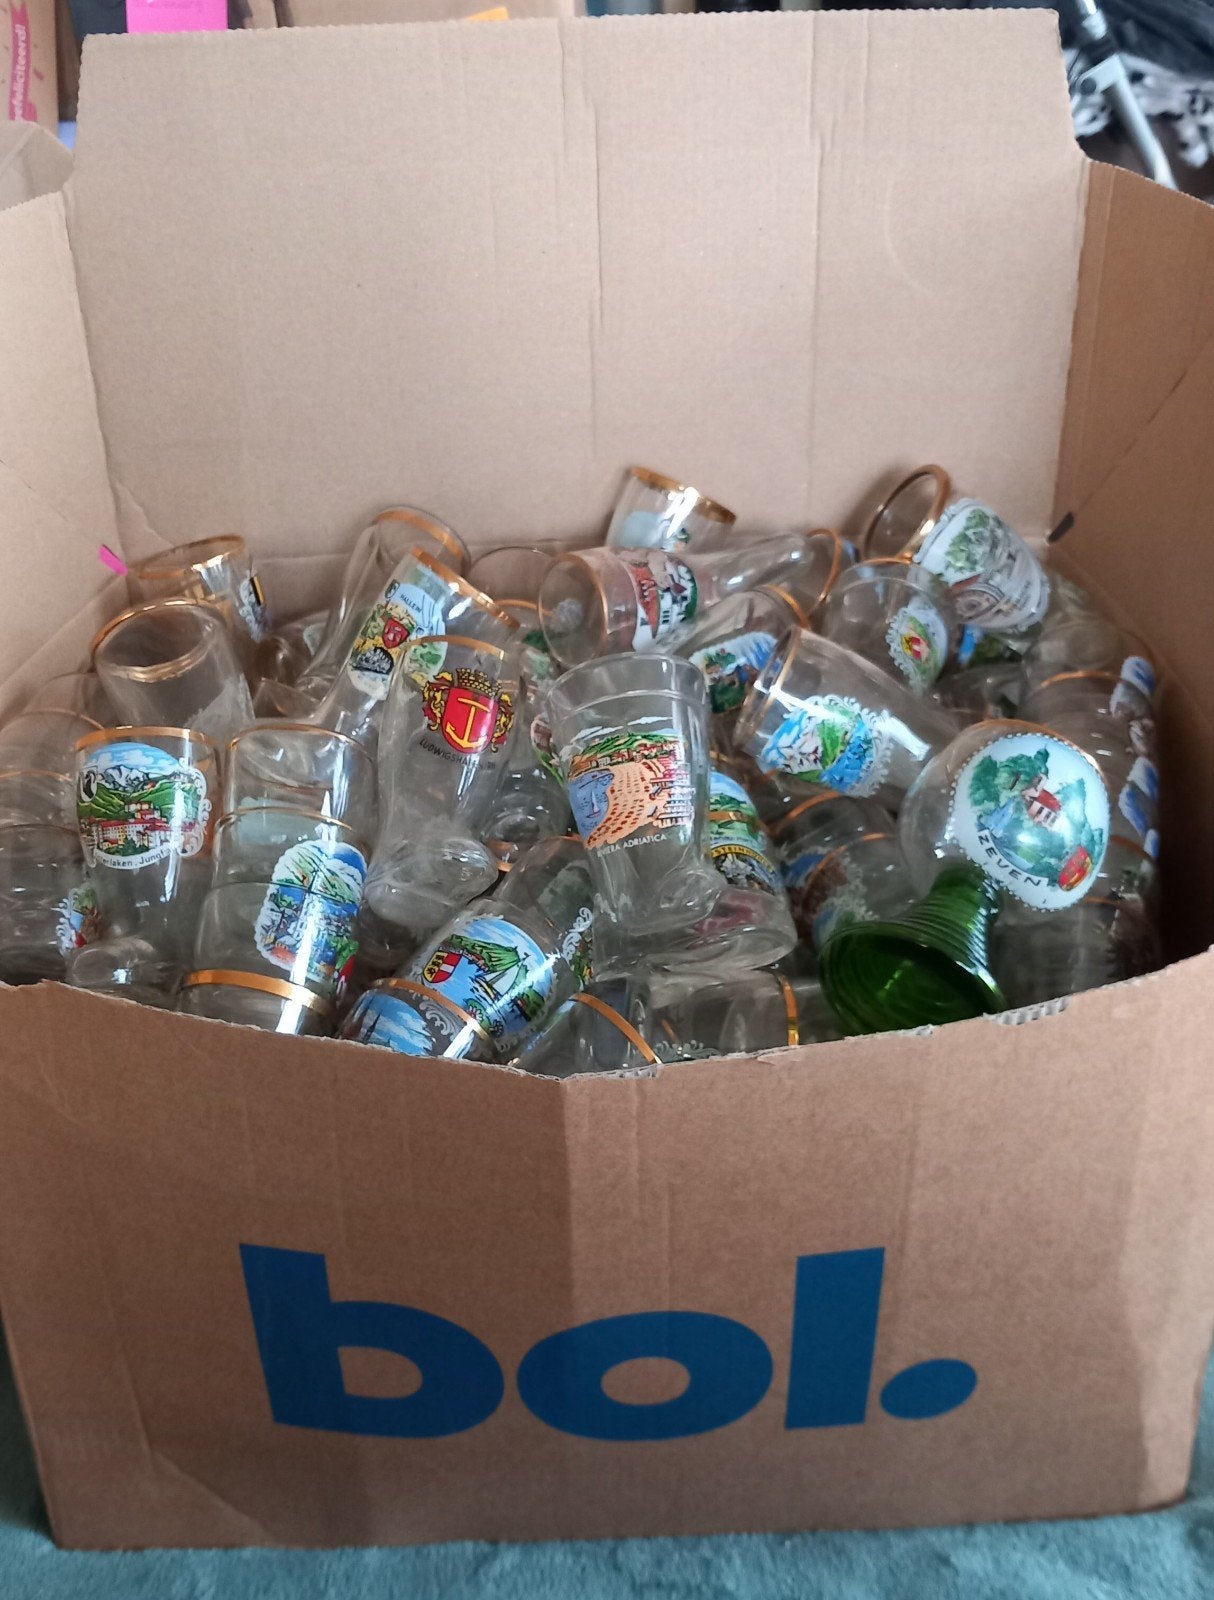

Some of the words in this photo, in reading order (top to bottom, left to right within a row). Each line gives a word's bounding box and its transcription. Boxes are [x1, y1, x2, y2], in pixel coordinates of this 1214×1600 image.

[623, 834, 667, 849] ADRIATICA
[978, 834, 1042, 887] ZEVEN
[239, 1243, 978, 1441] bol.
